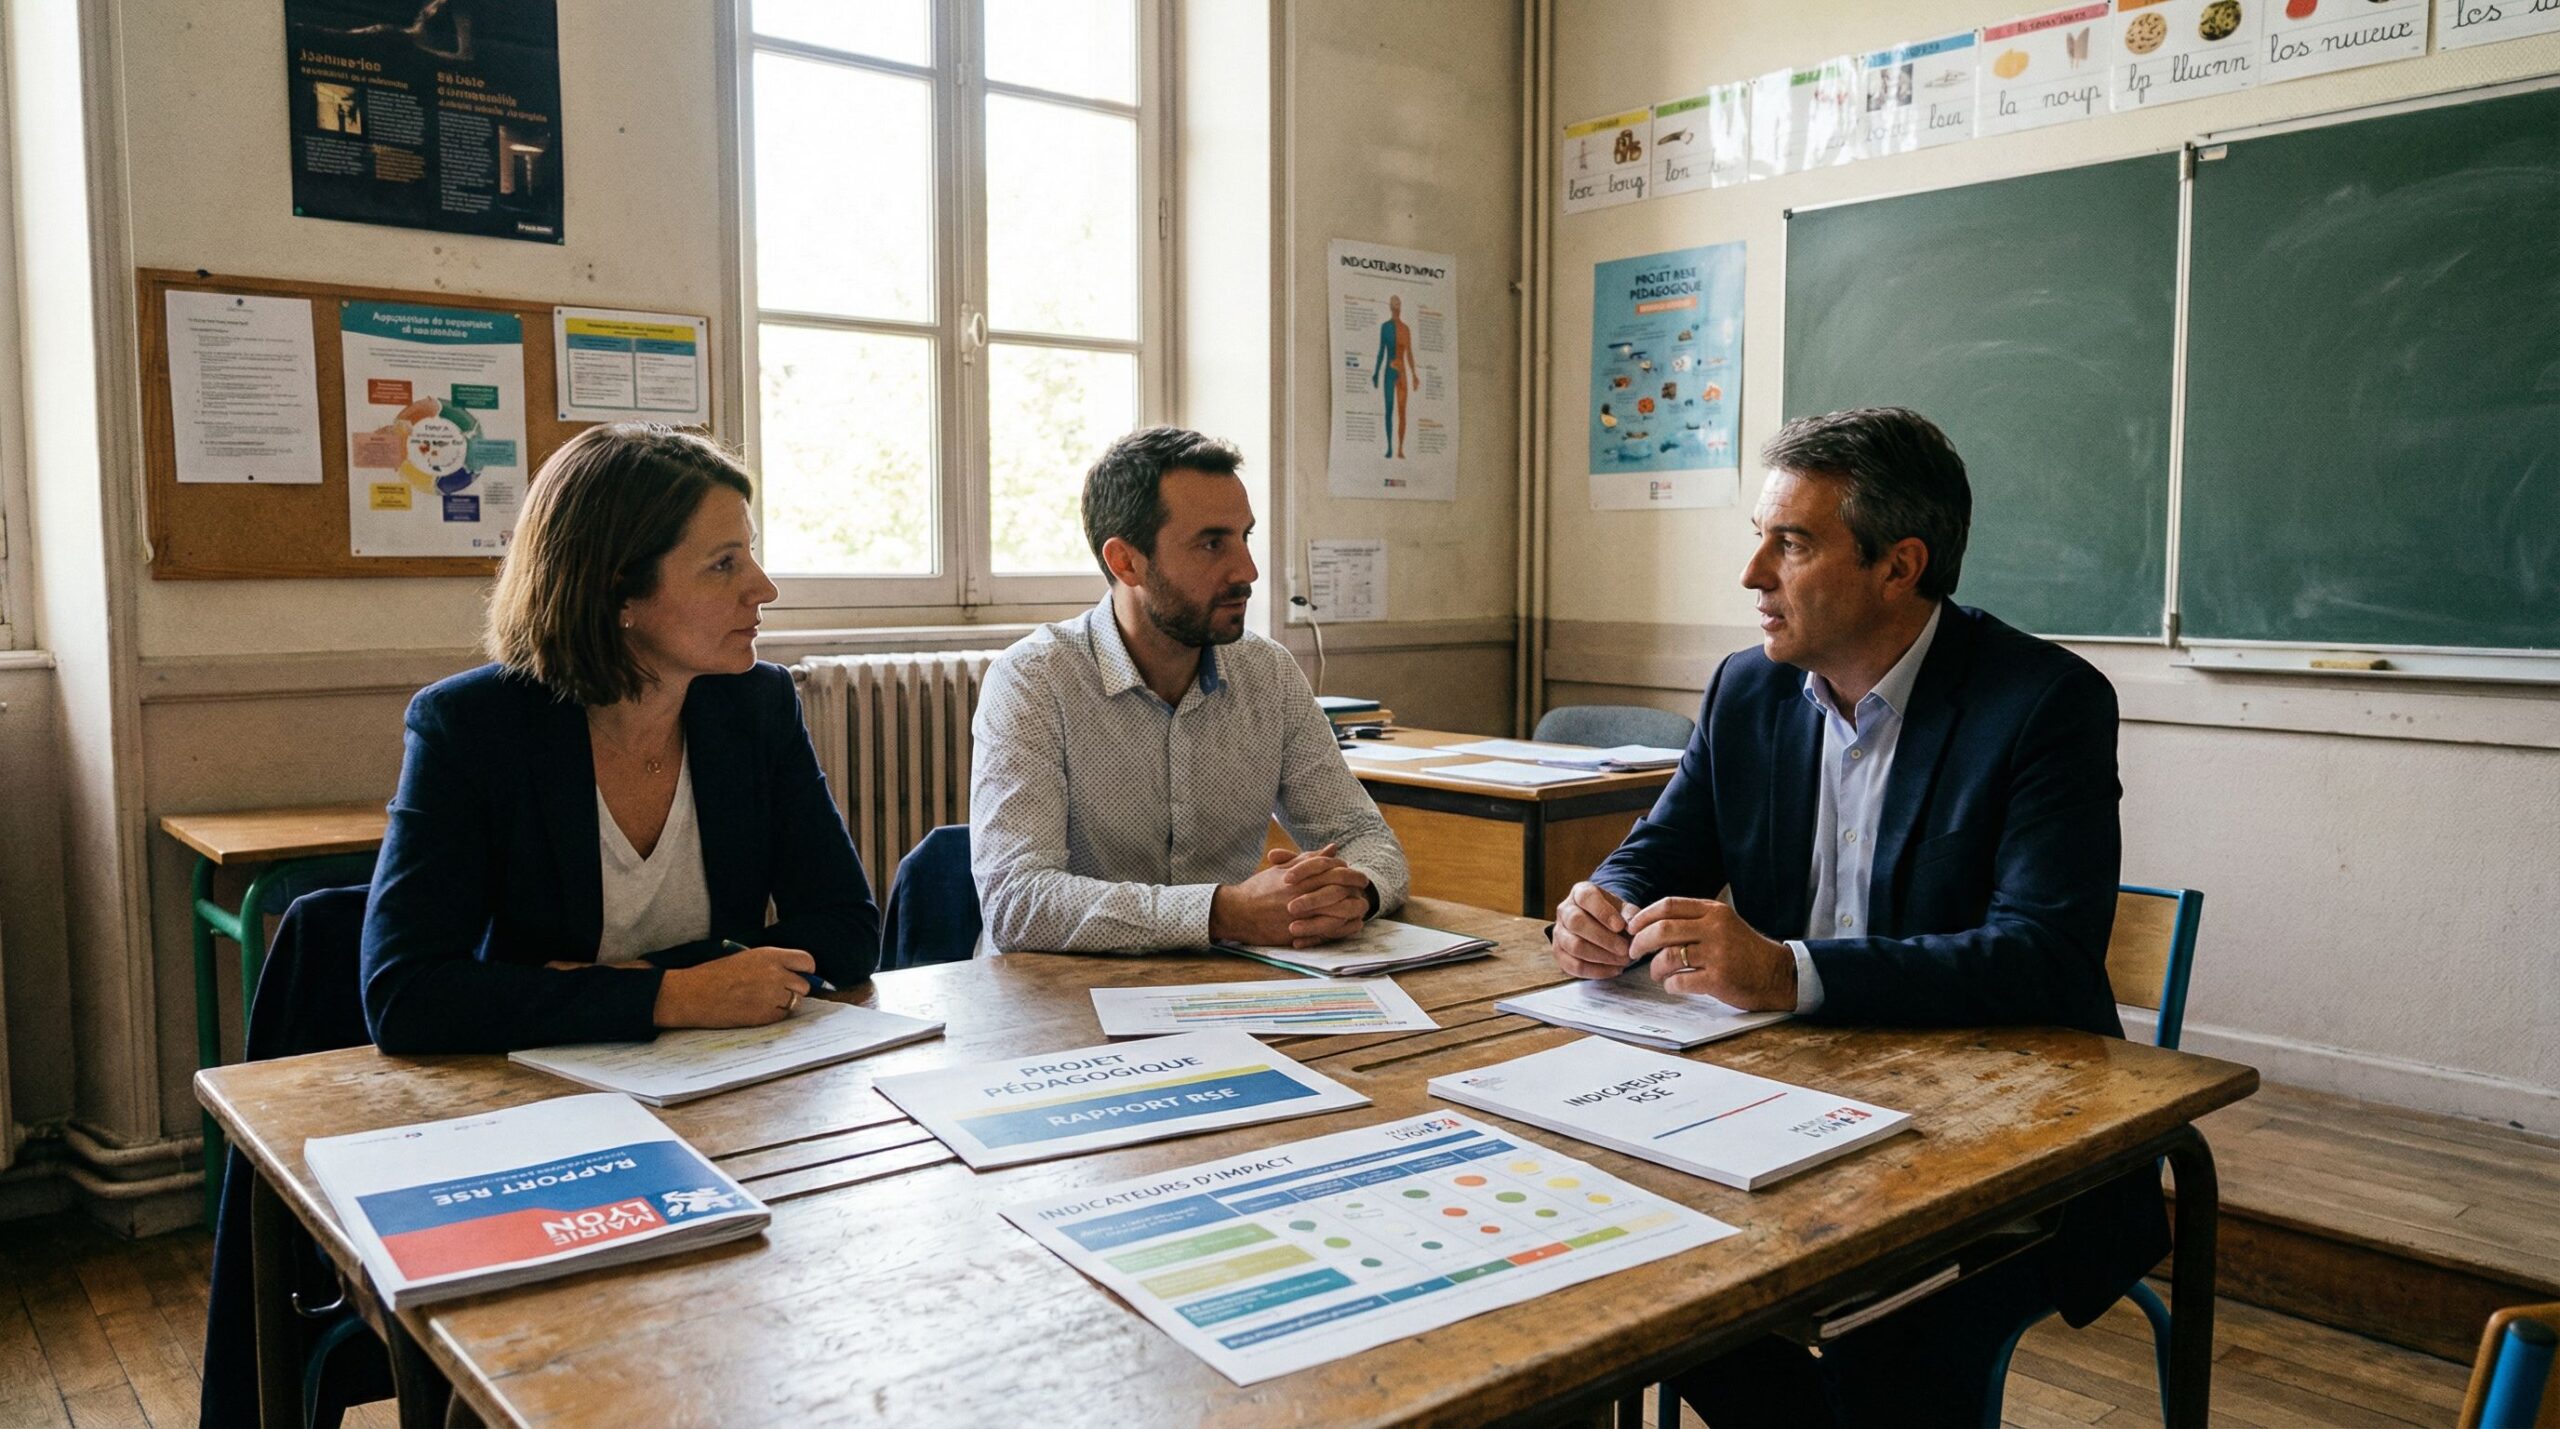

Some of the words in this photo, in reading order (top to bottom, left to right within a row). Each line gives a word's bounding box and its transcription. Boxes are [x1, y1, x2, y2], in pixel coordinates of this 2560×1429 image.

[983, 1055, 1205, 1098] PÉDAGOGIQUE
[1019, 1054, 1127, 1078] PROJET
[1562, 1069, 1682, 1107] INDICATEURS
[1626, 1087, 1675, 1104] RSE
[1044, 1096, 1182, 1128] RAPPORT
[1185, 1087, 1241, 1105] RSE
[501, 1157, 638, 1195] RAPPORT
[1037, 1179, 1191, 1221] INDICATEURS
[1192, 1155, 1295, 1186] D'IMPACT
[431, 1187, 493, 1206] RSE
[541, 1200, 651, 1237] LYON
[551, 1211, 657, 1247] MAIRIE
